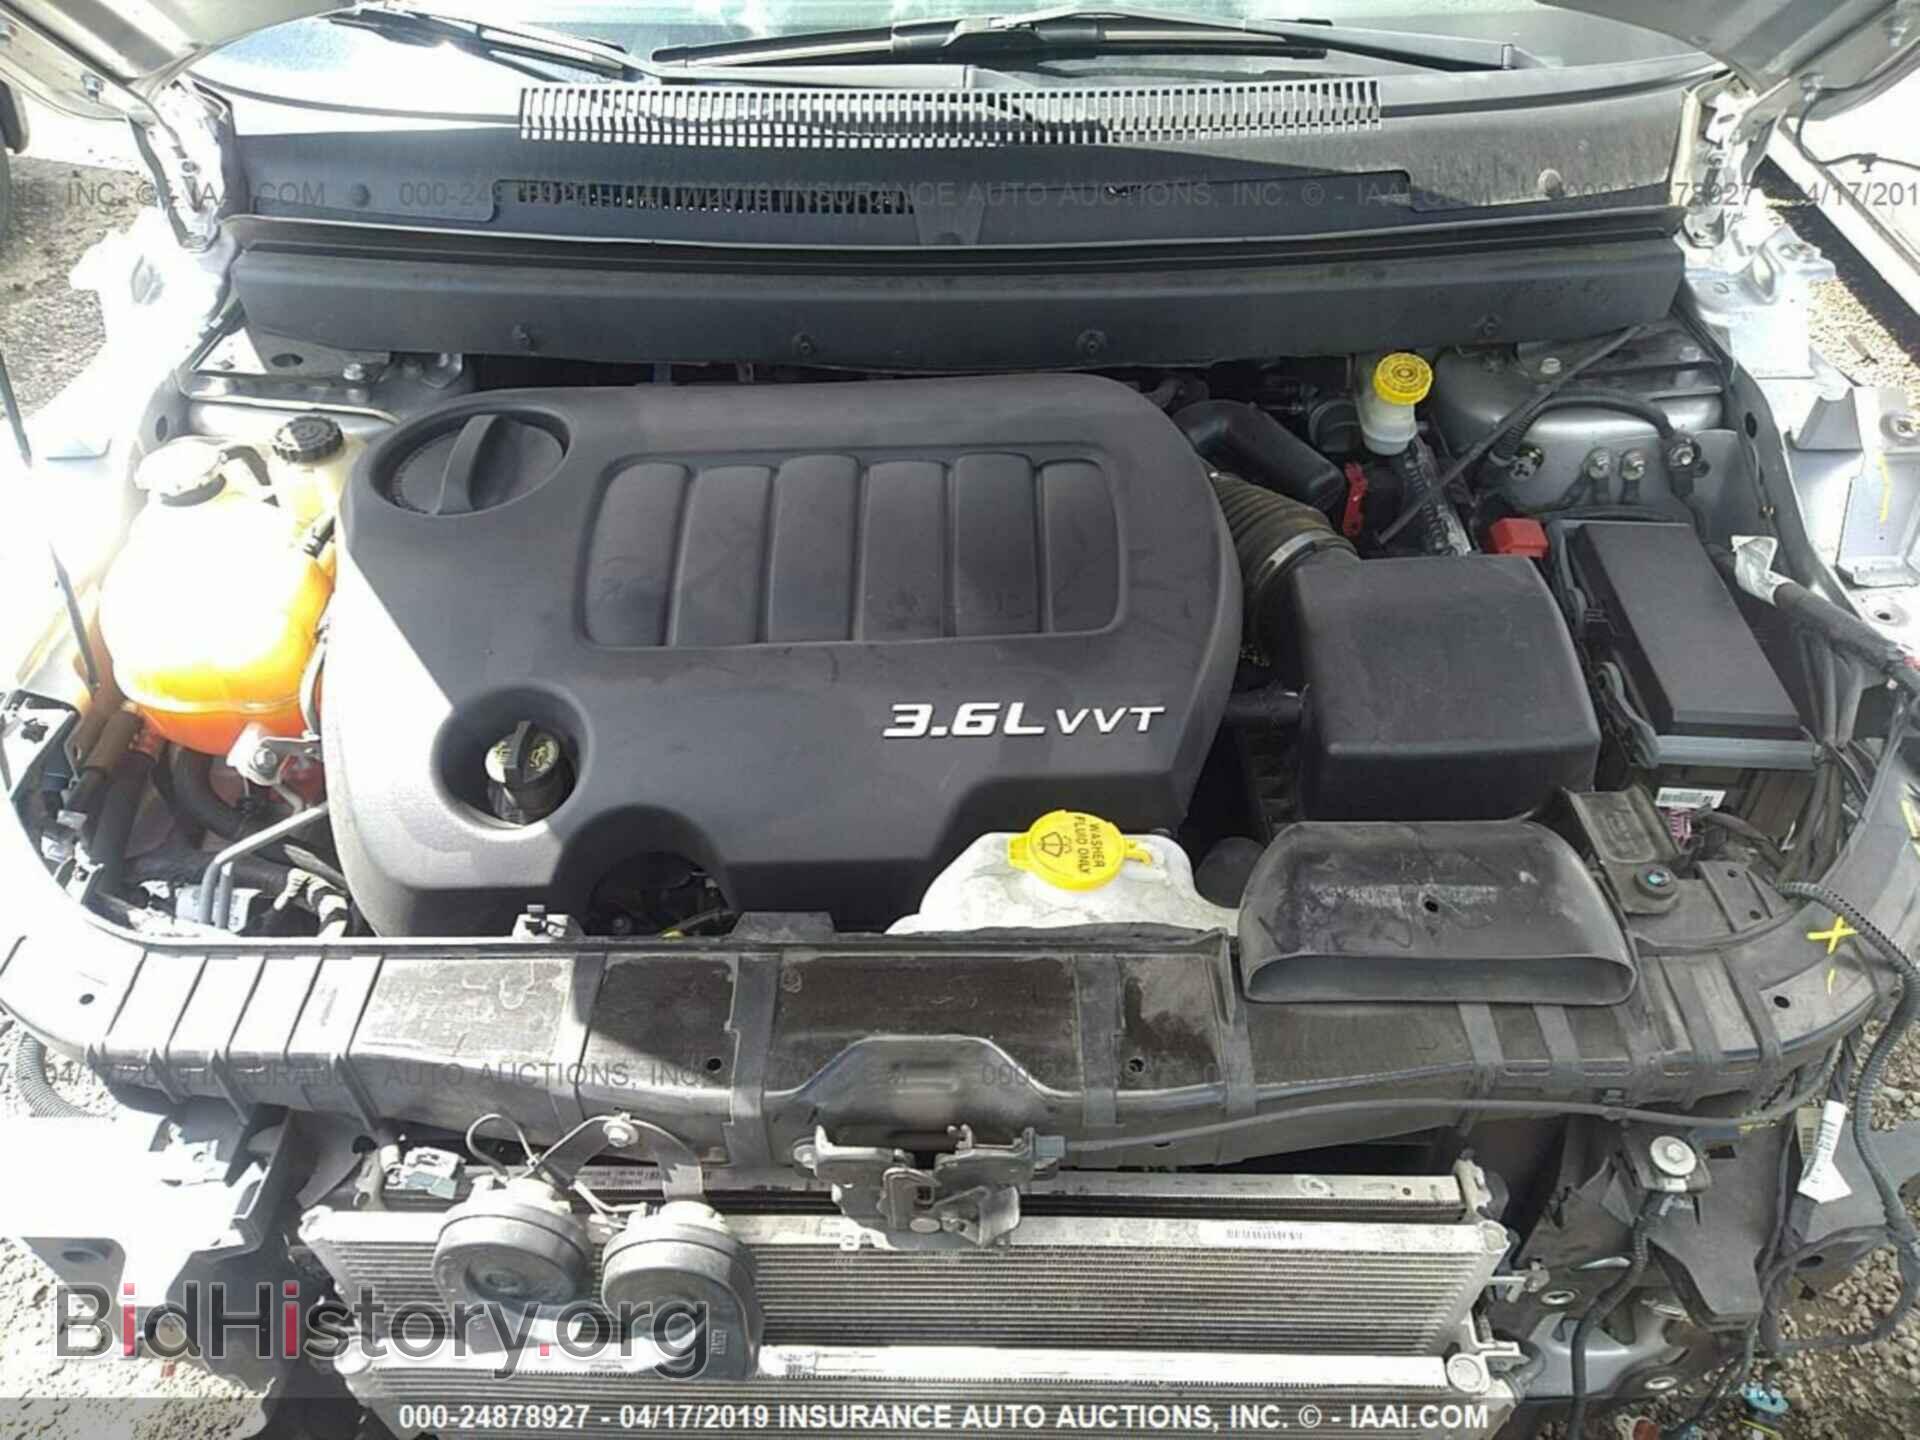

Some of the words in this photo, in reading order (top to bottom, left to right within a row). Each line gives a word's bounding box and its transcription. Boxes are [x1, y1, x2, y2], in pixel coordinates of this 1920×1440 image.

[882, 702, 1046, 737] 3.6L
[1055, 706, 1166, 735] VVT
[1074, 815, 1088, 845] FLUID
[1089, 822, 1106, 868] WASHER
[1077, 847, 1091, 876] ONLY
